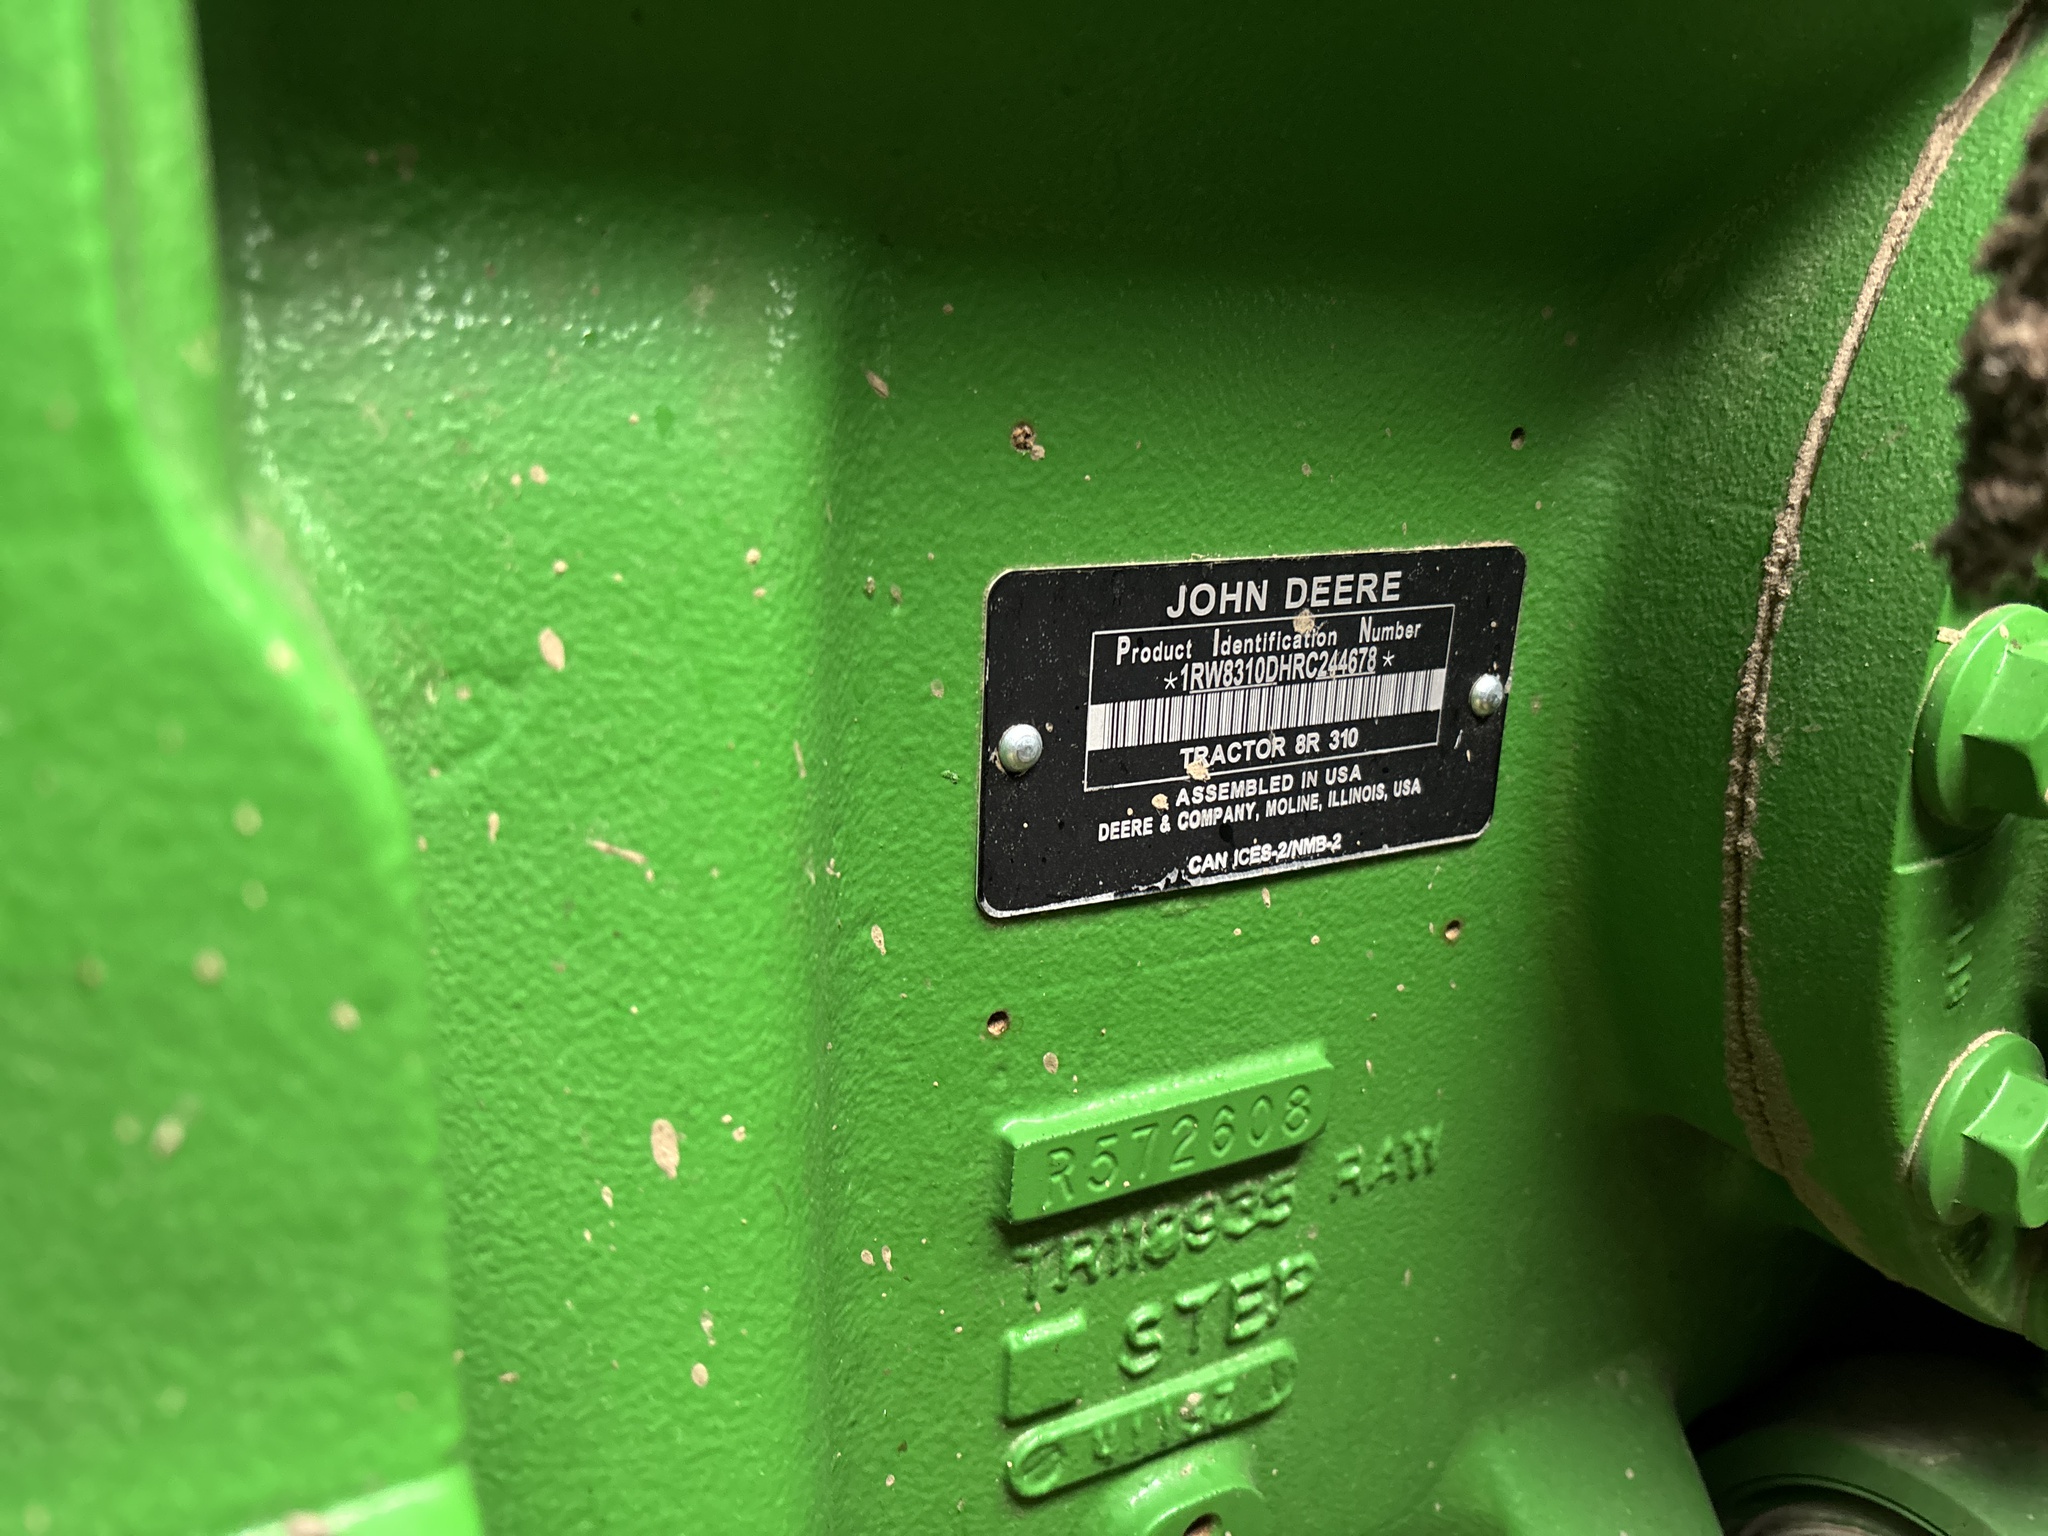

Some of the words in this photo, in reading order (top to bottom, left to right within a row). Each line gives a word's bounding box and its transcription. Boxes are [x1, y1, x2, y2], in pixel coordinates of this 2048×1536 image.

[1166, 579, 1269, 619] JOHN
[1285, 571, 1402, 609] DEERE
[1116, 635, 1193, 666] Product
[1212, 626, 1338, 657] Identification
[1359, 616, 1422, 643] Number
[1180, 736, 1286, 770] TRACTOR
[1295, 732, 1320, 755] 8R
[1329, 727, 1359, 751] 310
[1098, 817, 1153, 842] DEERE
[1159, 814, 1171, 834] &
[1177, 802, 1260, 831] COMPANY,
[1266, 793, 1323, 817] MOLINE,
[1328, 783, 1388, 808] ILLINOIS,
[1393, 778, 1422, 798] USA
[1175, 774, 1294, 807] ASSEMBLED
[1301, 770, 1318, 789] IN
[1325, 764, 1362, 785] USA
[1188, 851, 1228, 875] CAN
[1233, 833, 1342, 867] ICES-2/NMB-2
[1043, 1084, 1312, 1206] R572608
[1118, 1251, 1319, 1376] STEP
